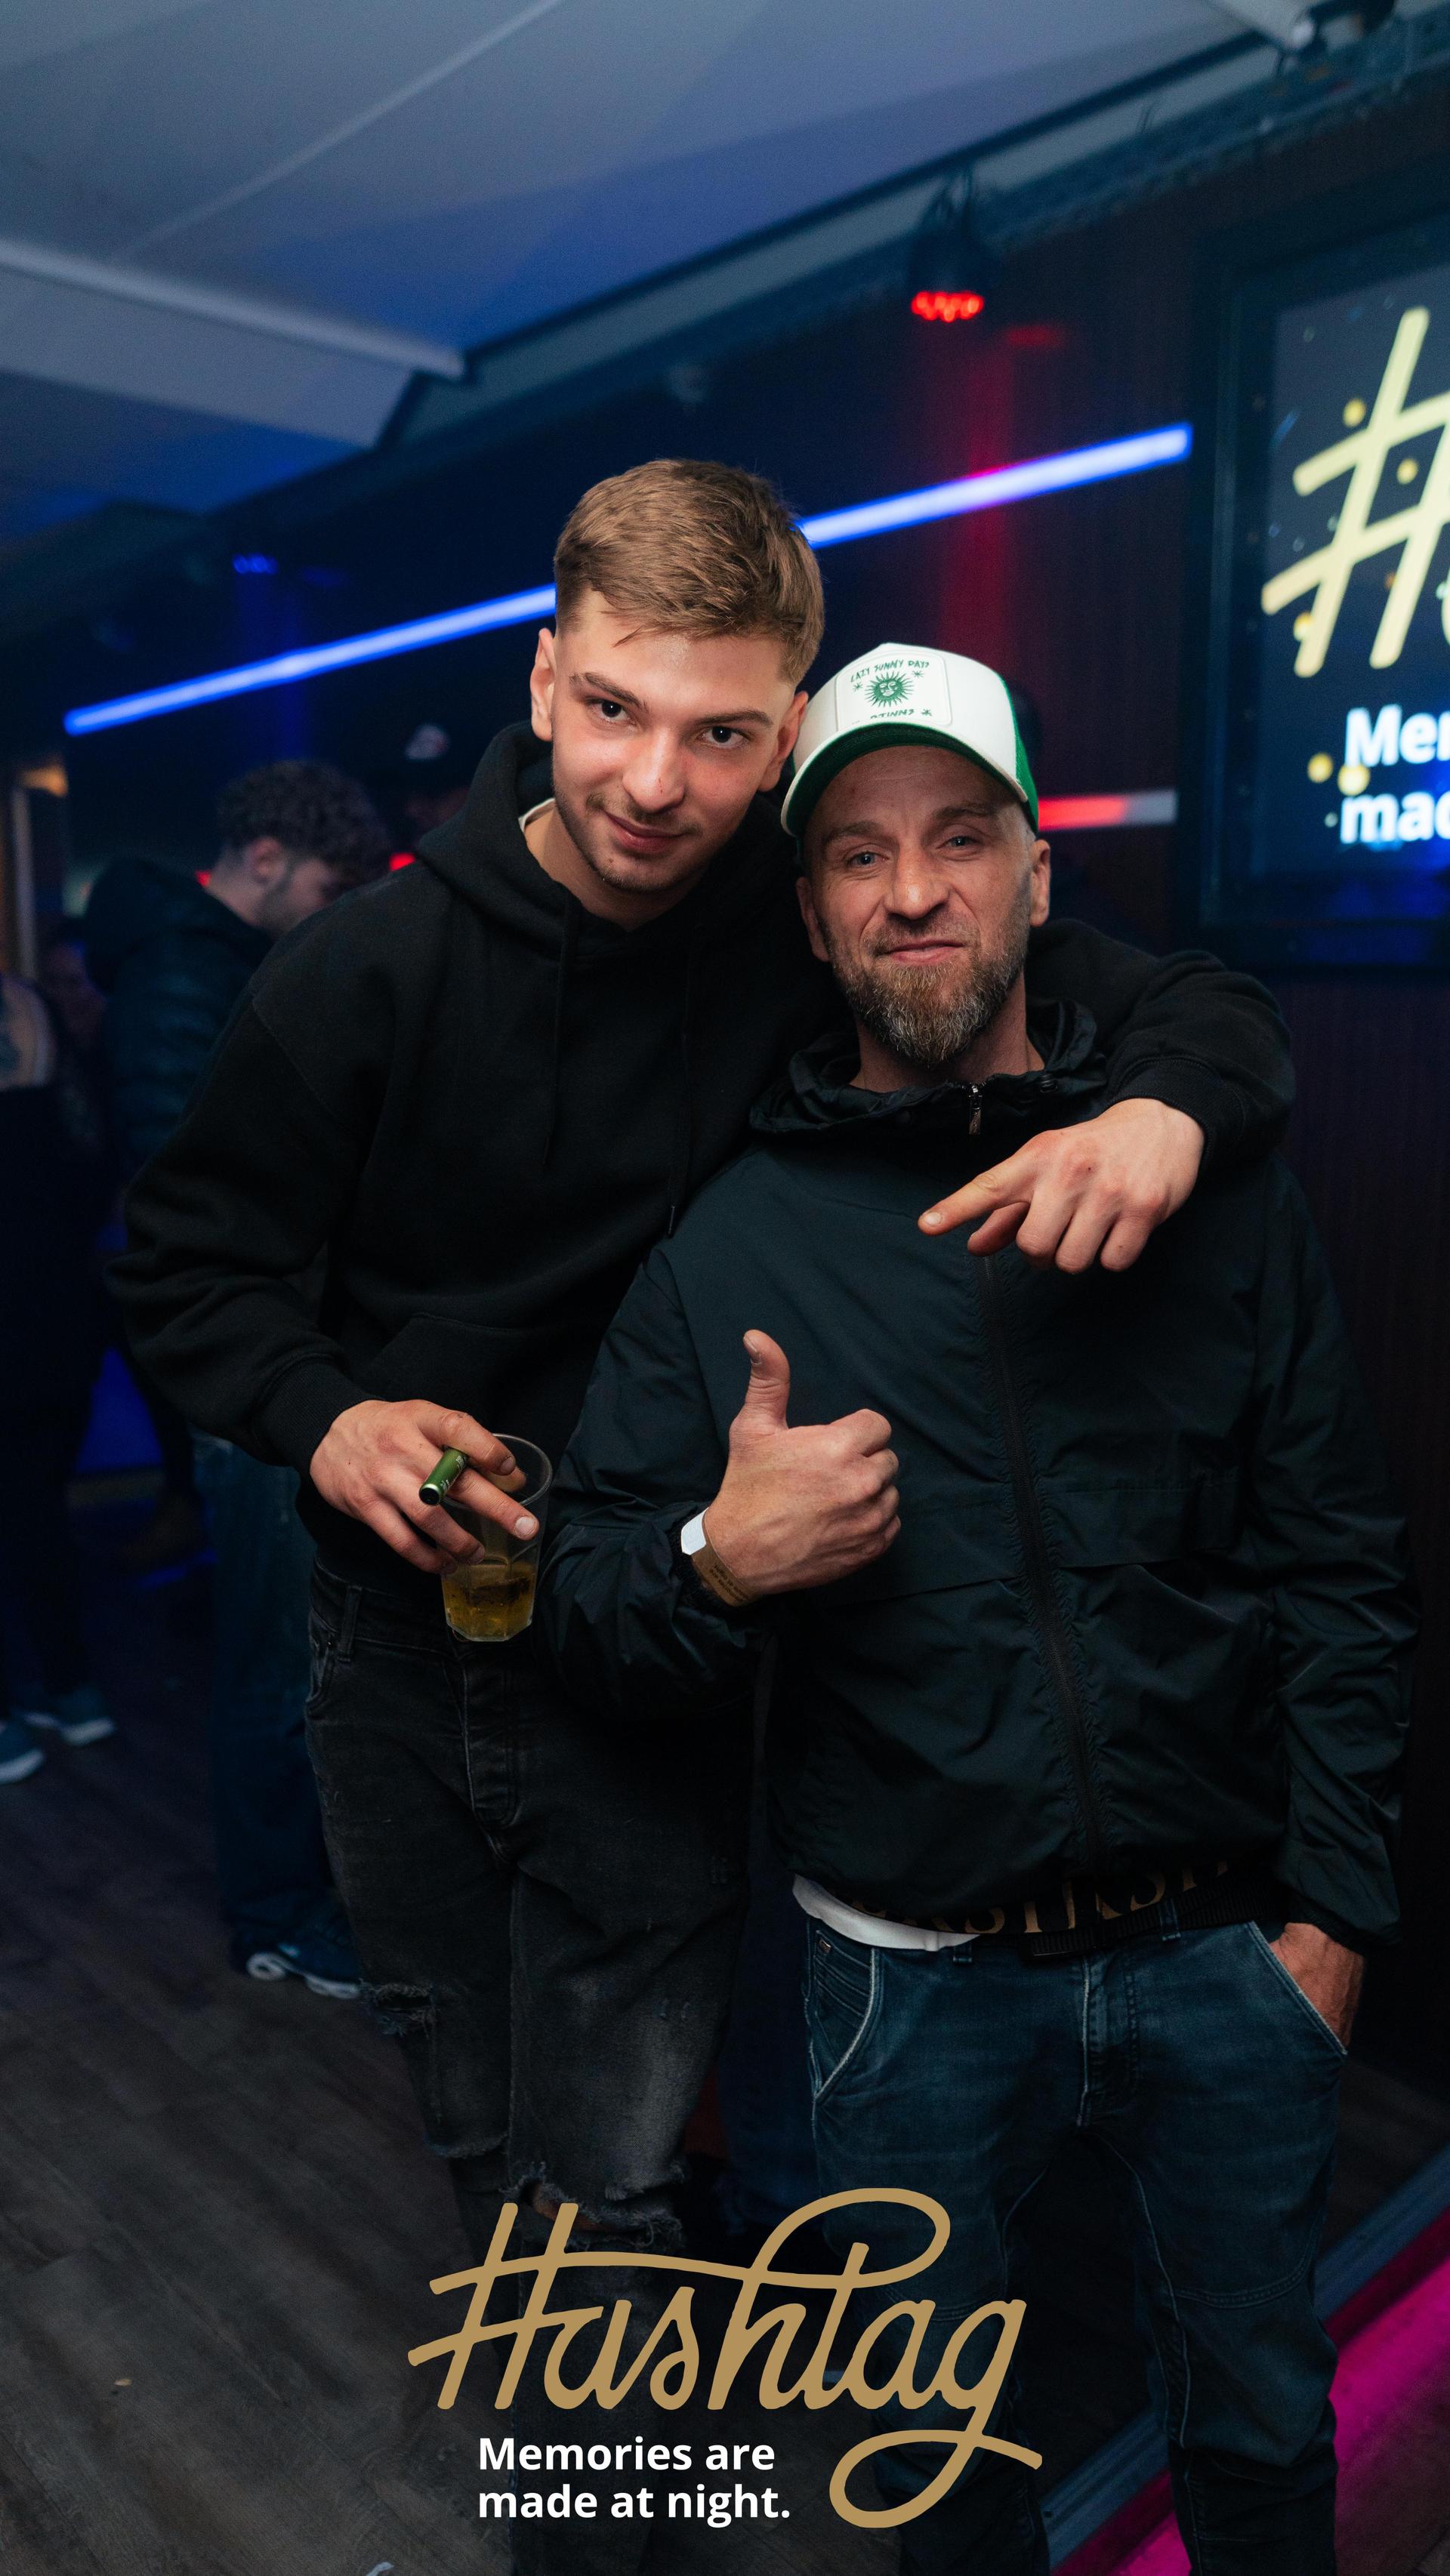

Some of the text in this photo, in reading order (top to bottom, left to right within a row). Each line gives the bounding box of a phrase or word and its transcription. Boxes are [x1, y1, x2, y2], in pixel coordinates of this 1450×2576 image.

[851, 659, 930, 683] LAZY SUNNY DAYS
